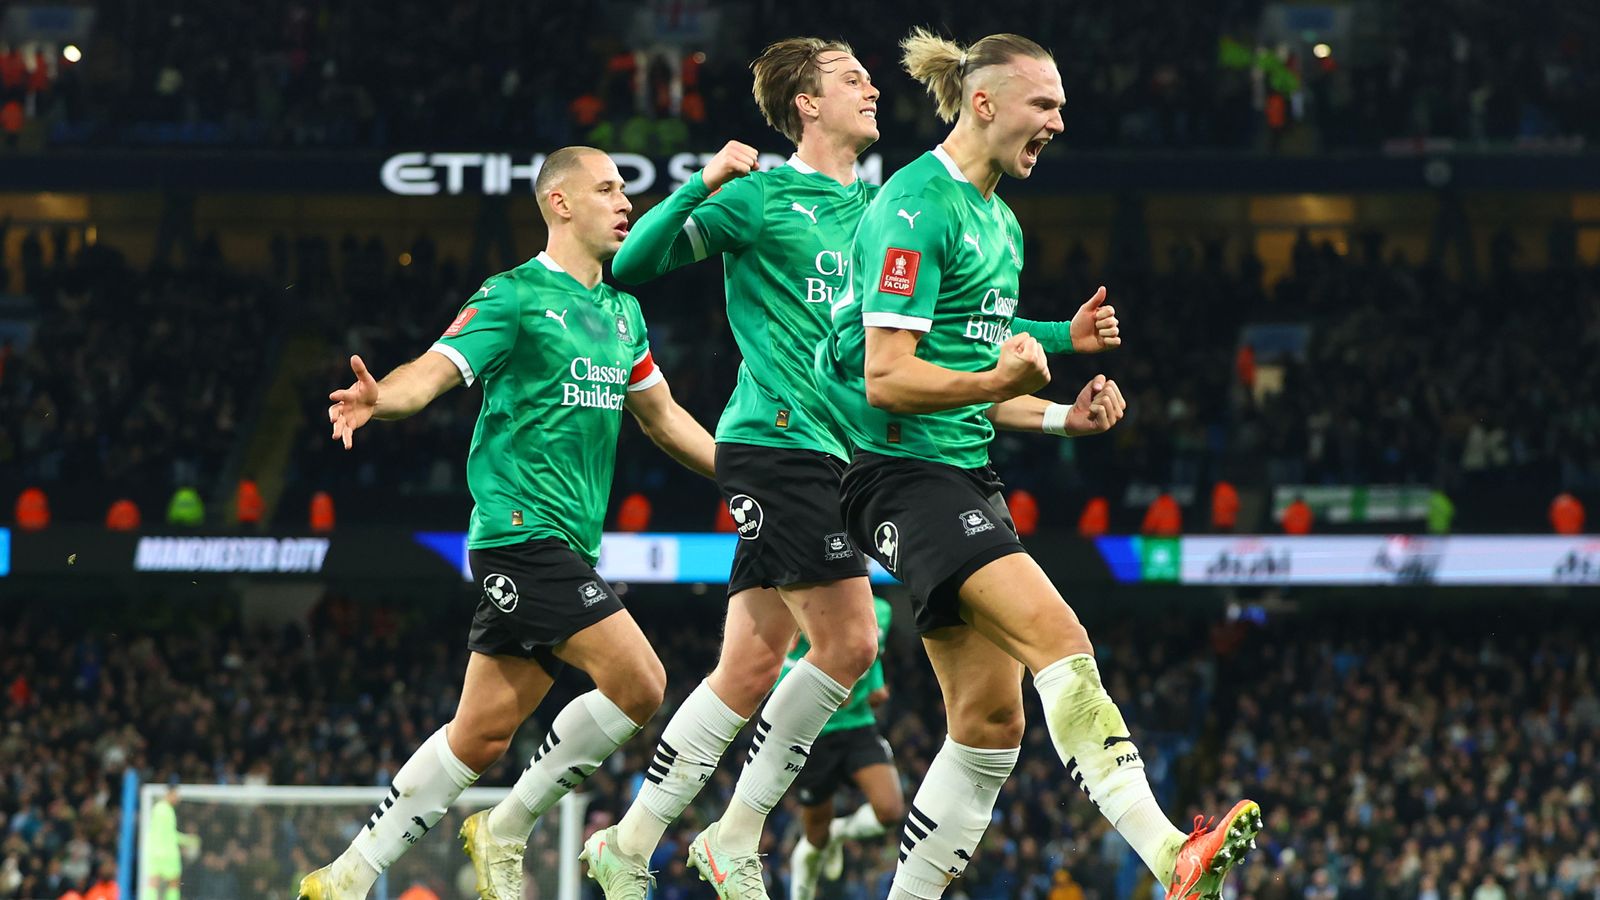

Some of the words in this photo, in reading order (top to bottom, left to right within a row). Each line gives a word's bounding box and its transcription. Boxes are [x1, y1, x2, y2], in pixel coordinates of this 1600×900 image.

[380, 152, 656, 196] ETIHD
[884, 280, 893, 288] FA
[893, 281, 910, 290] CUP
[570, 356, 627, 385] Classic
[737, 519, 758, 535] retain
[134, 537, 278, 572] MANCHESTER
[277, 537, 330, 572] CITY
